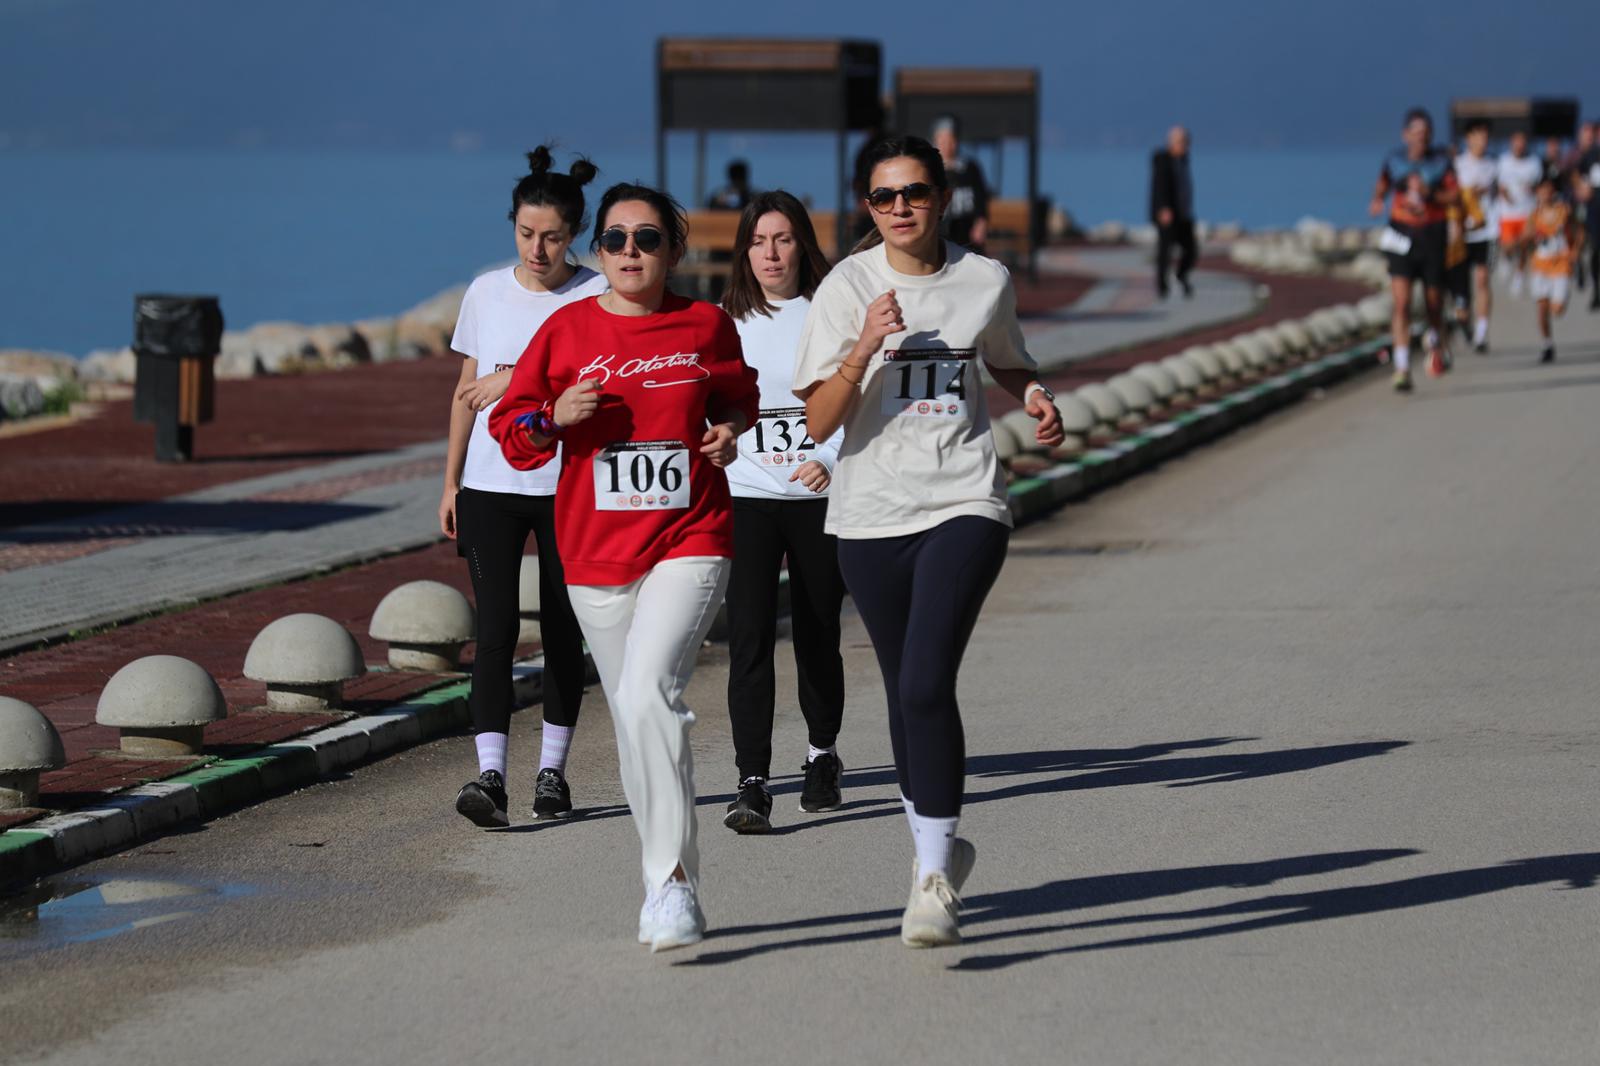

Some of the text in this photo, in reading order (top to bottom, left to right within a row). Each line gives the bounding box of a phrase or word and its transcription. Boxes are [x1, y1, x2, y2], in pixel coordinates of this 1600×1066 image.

[893, 362, 968, 401] 114
[752, 418, 816, 454] 132
[602, 452, 683, 493] 106
